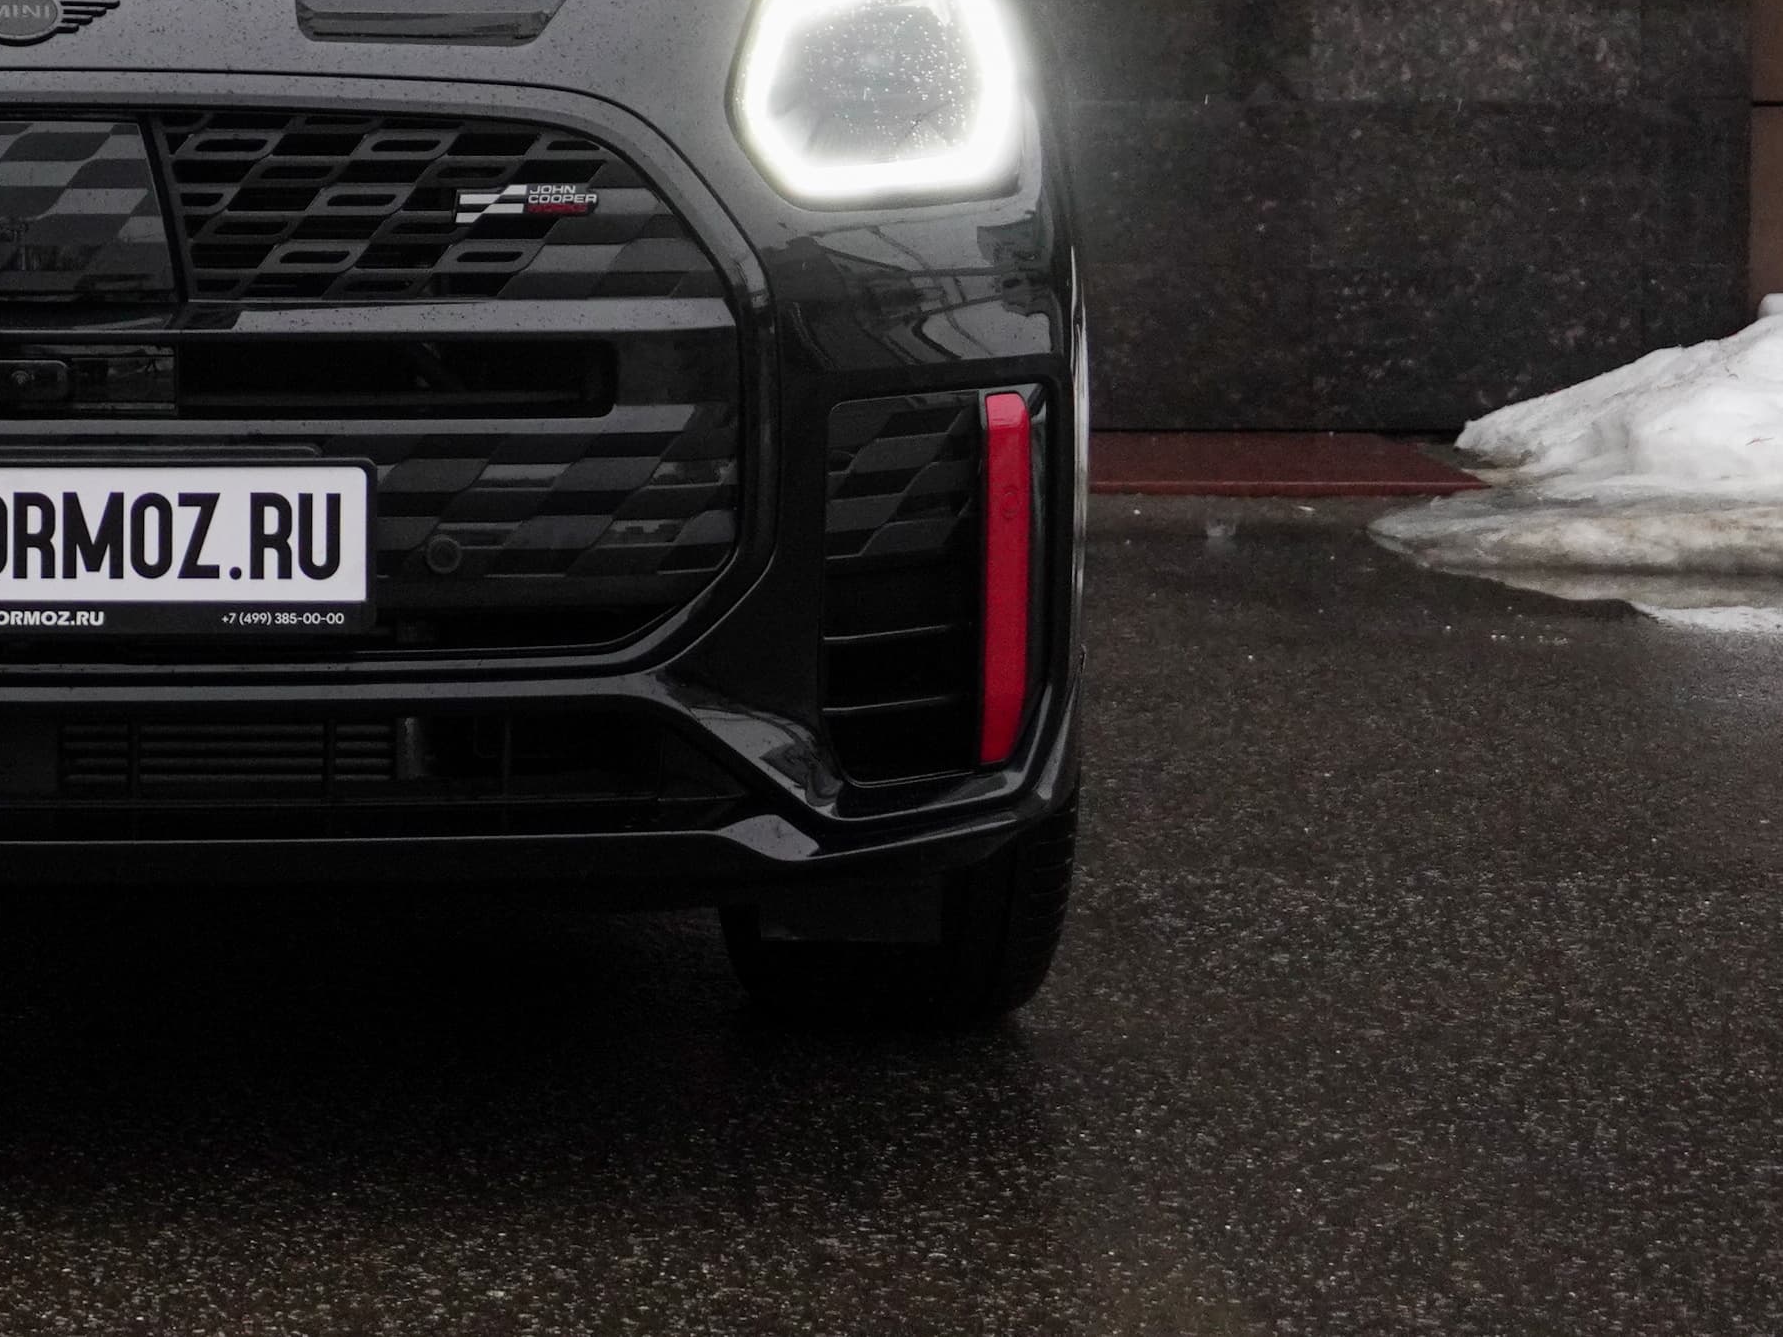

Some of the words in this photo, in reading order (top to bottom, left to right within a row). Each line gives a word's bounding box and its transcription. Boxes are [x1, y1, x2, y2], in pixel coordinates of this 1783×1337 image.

[529, 185, 576, 194] JOHN
[528, 194, 597, 203] COOPER
[221, 613, 236, 624] +7
[239, 612, 272, 626] (499)
[274, 612, 345, 625] 385-00-00
